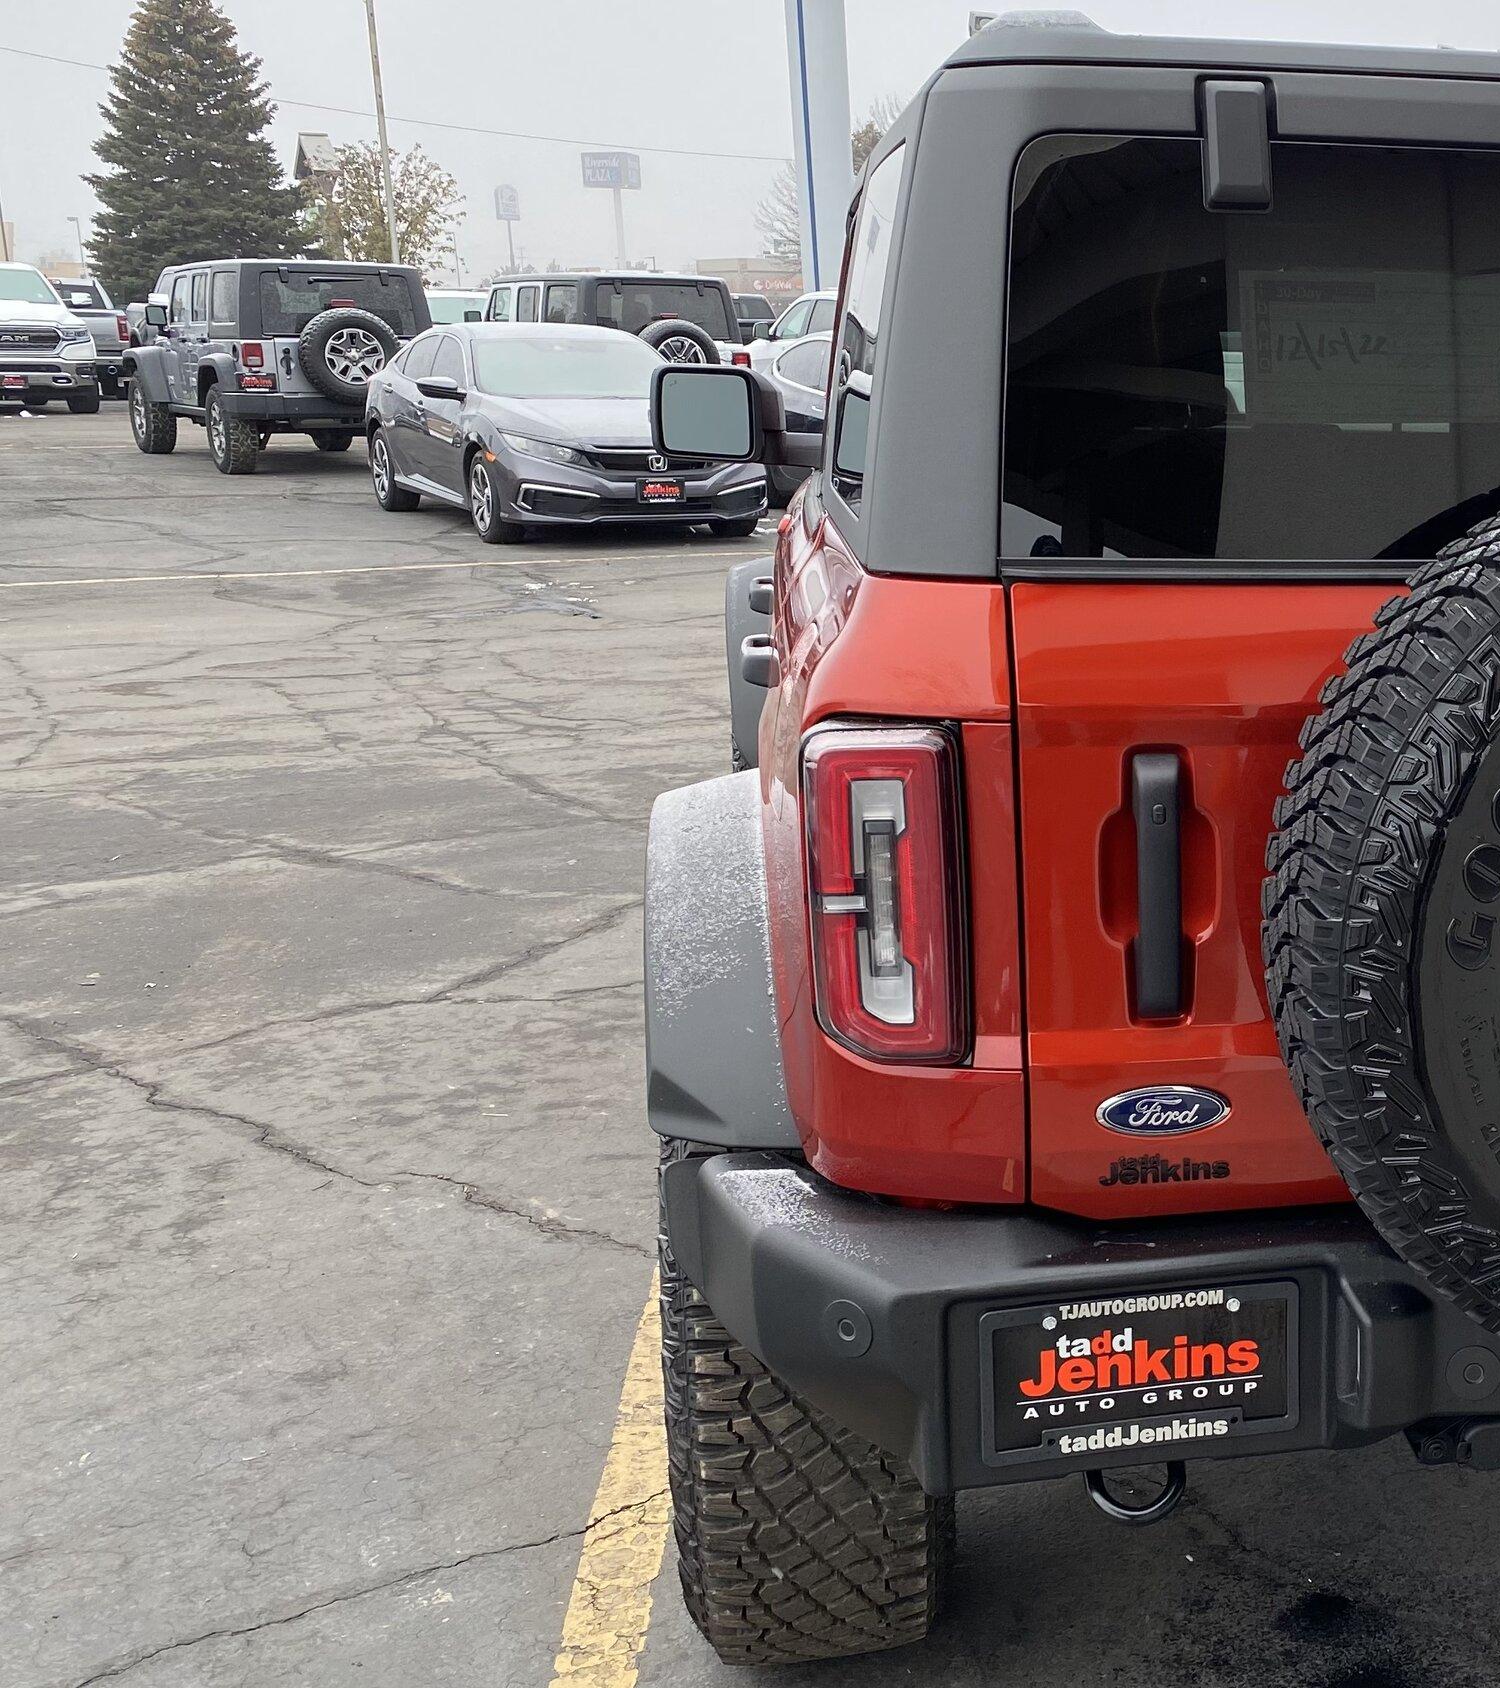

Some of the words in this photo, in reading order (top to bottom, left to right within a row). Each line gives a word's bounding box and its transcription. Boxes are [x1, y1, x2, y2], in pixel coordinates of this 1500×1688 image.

[1128, 1095, 1200, 1127] Ford
[1098, 1157, 1231, 1187] Jenkins
[1059, 1289, 1224, 1321] TJAUTOGROUP.COM
[1055, 1327, 1133, 1359] tadd
[1019, 1335, 1261, 1397] Jenkins
[1023, 1397, 1115, 1420] AUTO
[1142, 1381, 1259, 1404] GROUP
[1058, 1417, 1229, 1454] taddJenkins
